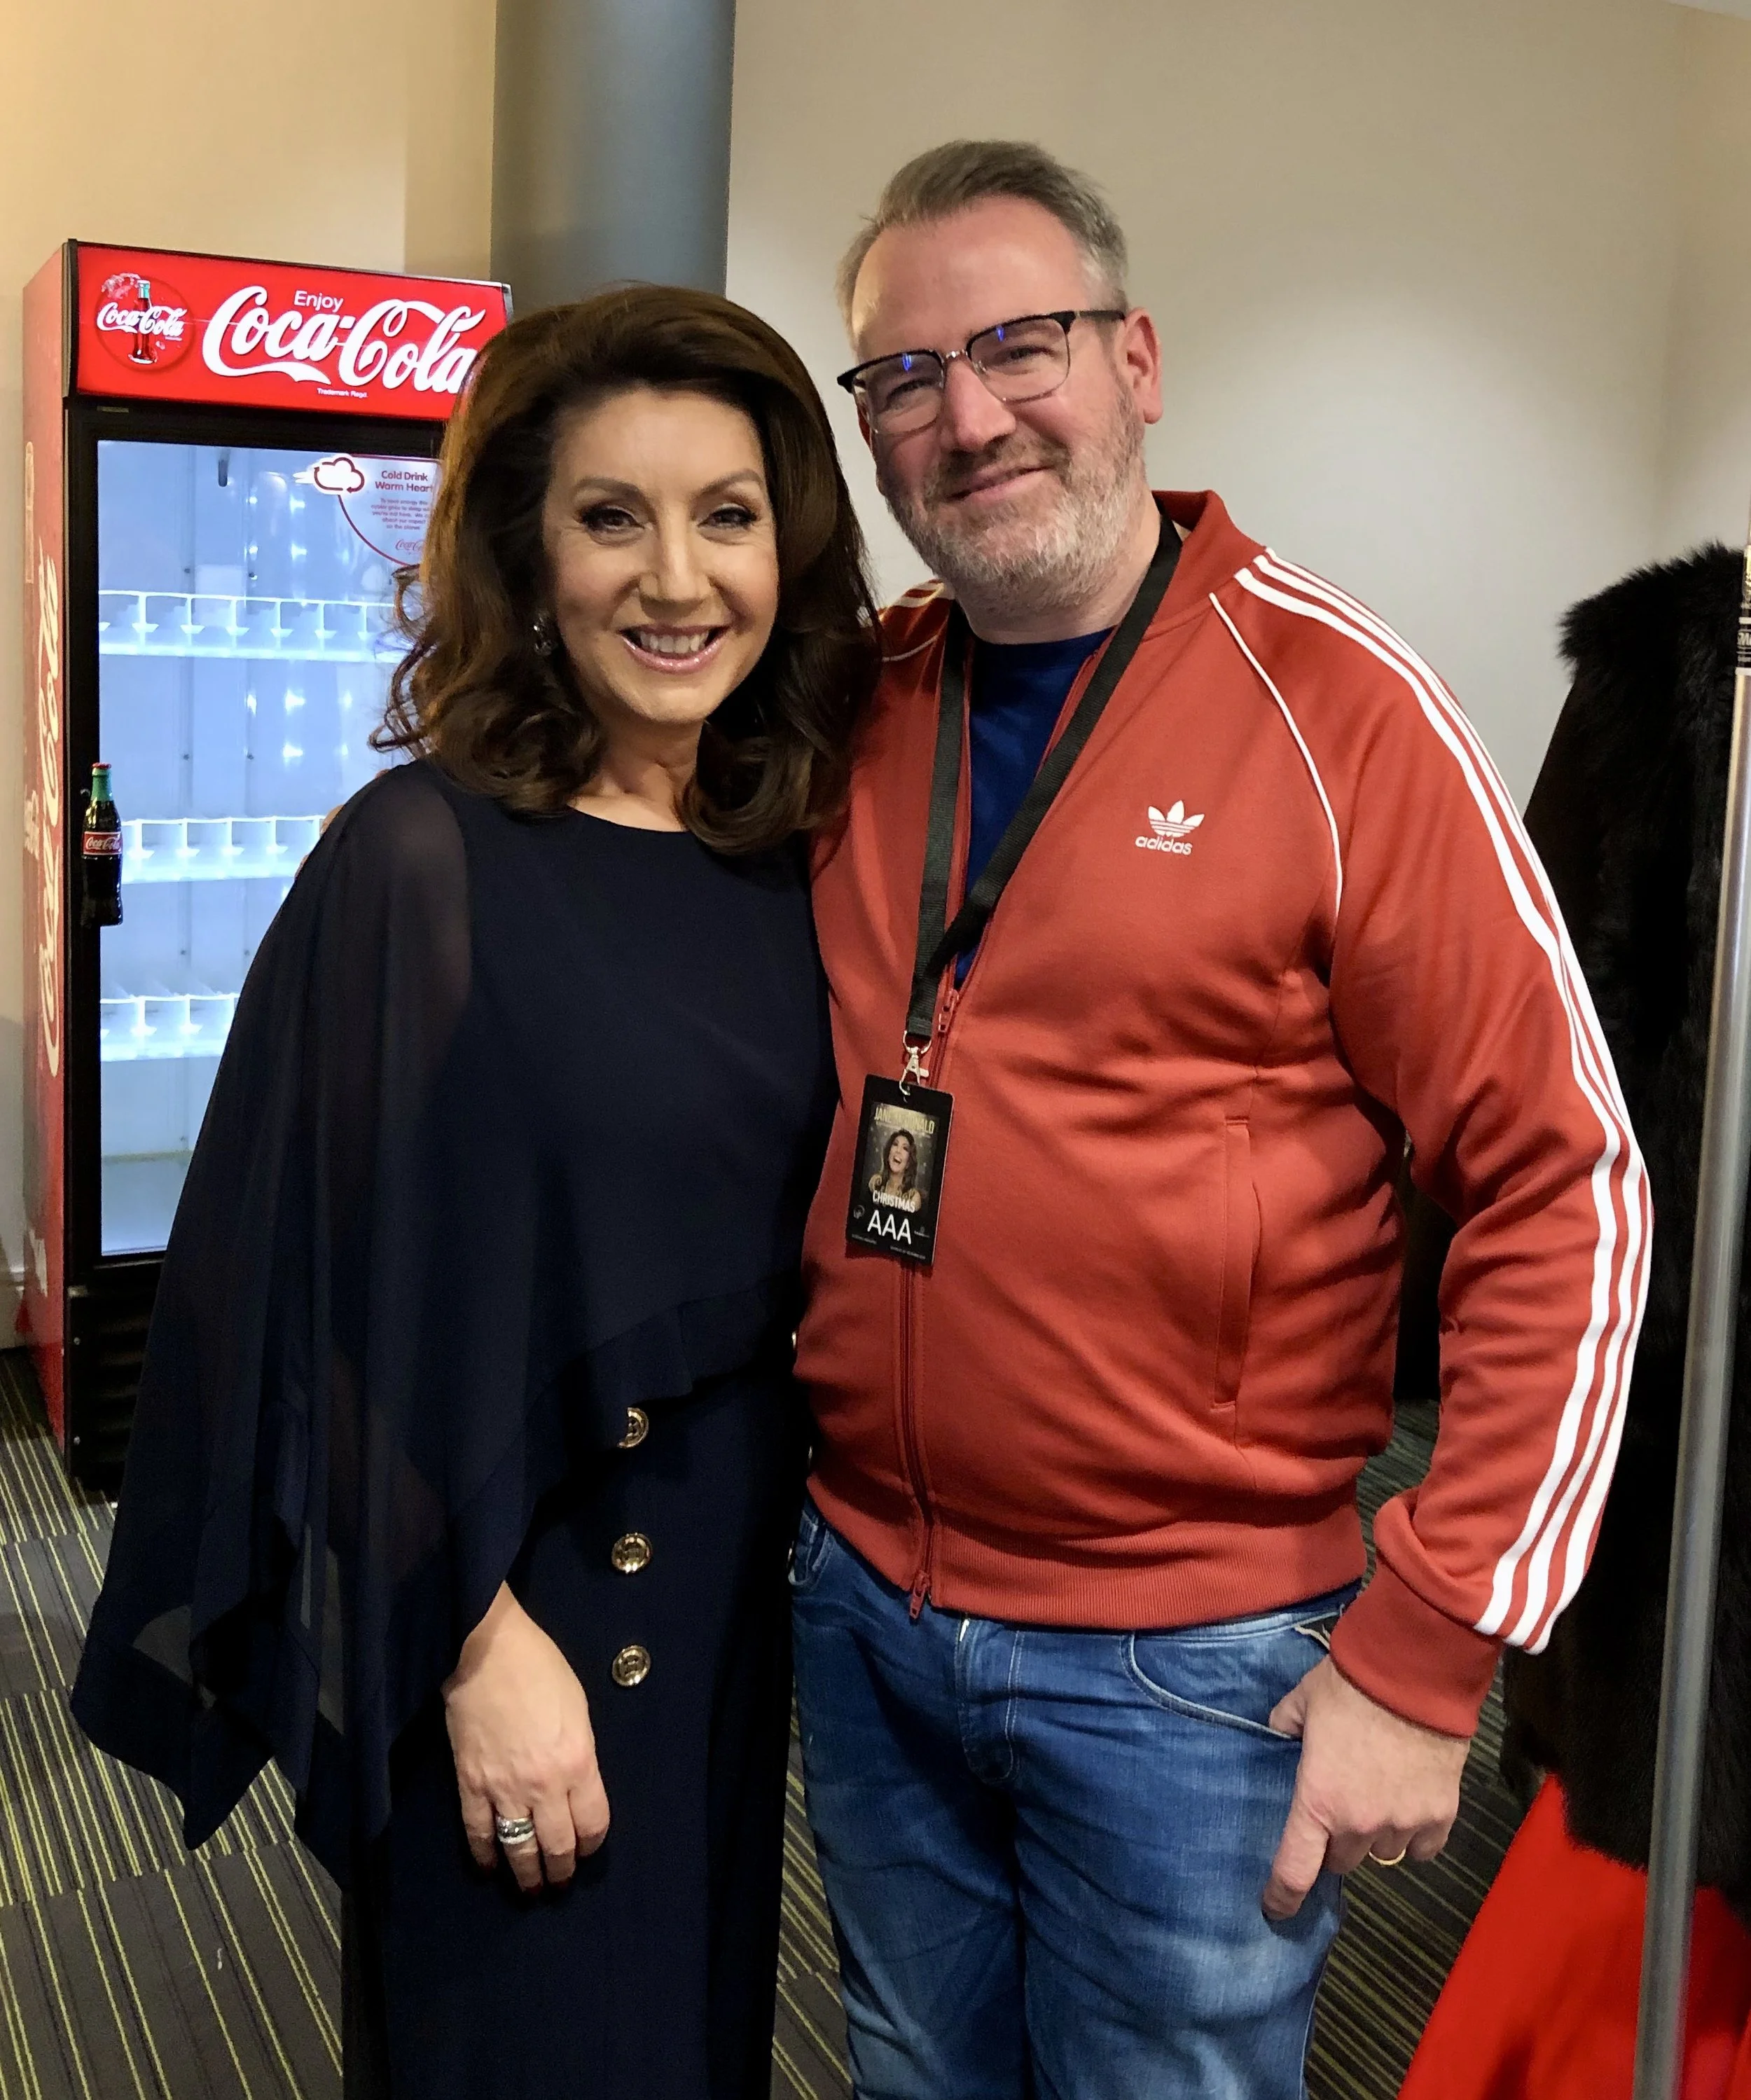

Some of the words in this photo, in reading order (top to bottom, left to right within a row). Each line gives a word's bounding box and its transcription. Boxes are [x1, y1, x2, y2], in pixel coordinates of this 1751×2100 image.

[294, 290, 344, 313] Enjoy
[97, 302, 187, 337] Coca-Cola
[202, 285, 486, 394] Coca-Cola
[375, 481, 403, 490] Warm
[381, 470, 402, 480] Cold
[404, 471, 428, 481] Drink
[39, 535, 59, 1077] Coca-Cola
[1135, 836, 1193, 855] adidas
[873, 1190, 915, 1213] CHRISTMAS
[867, 1210, 911, 1244] AAA
